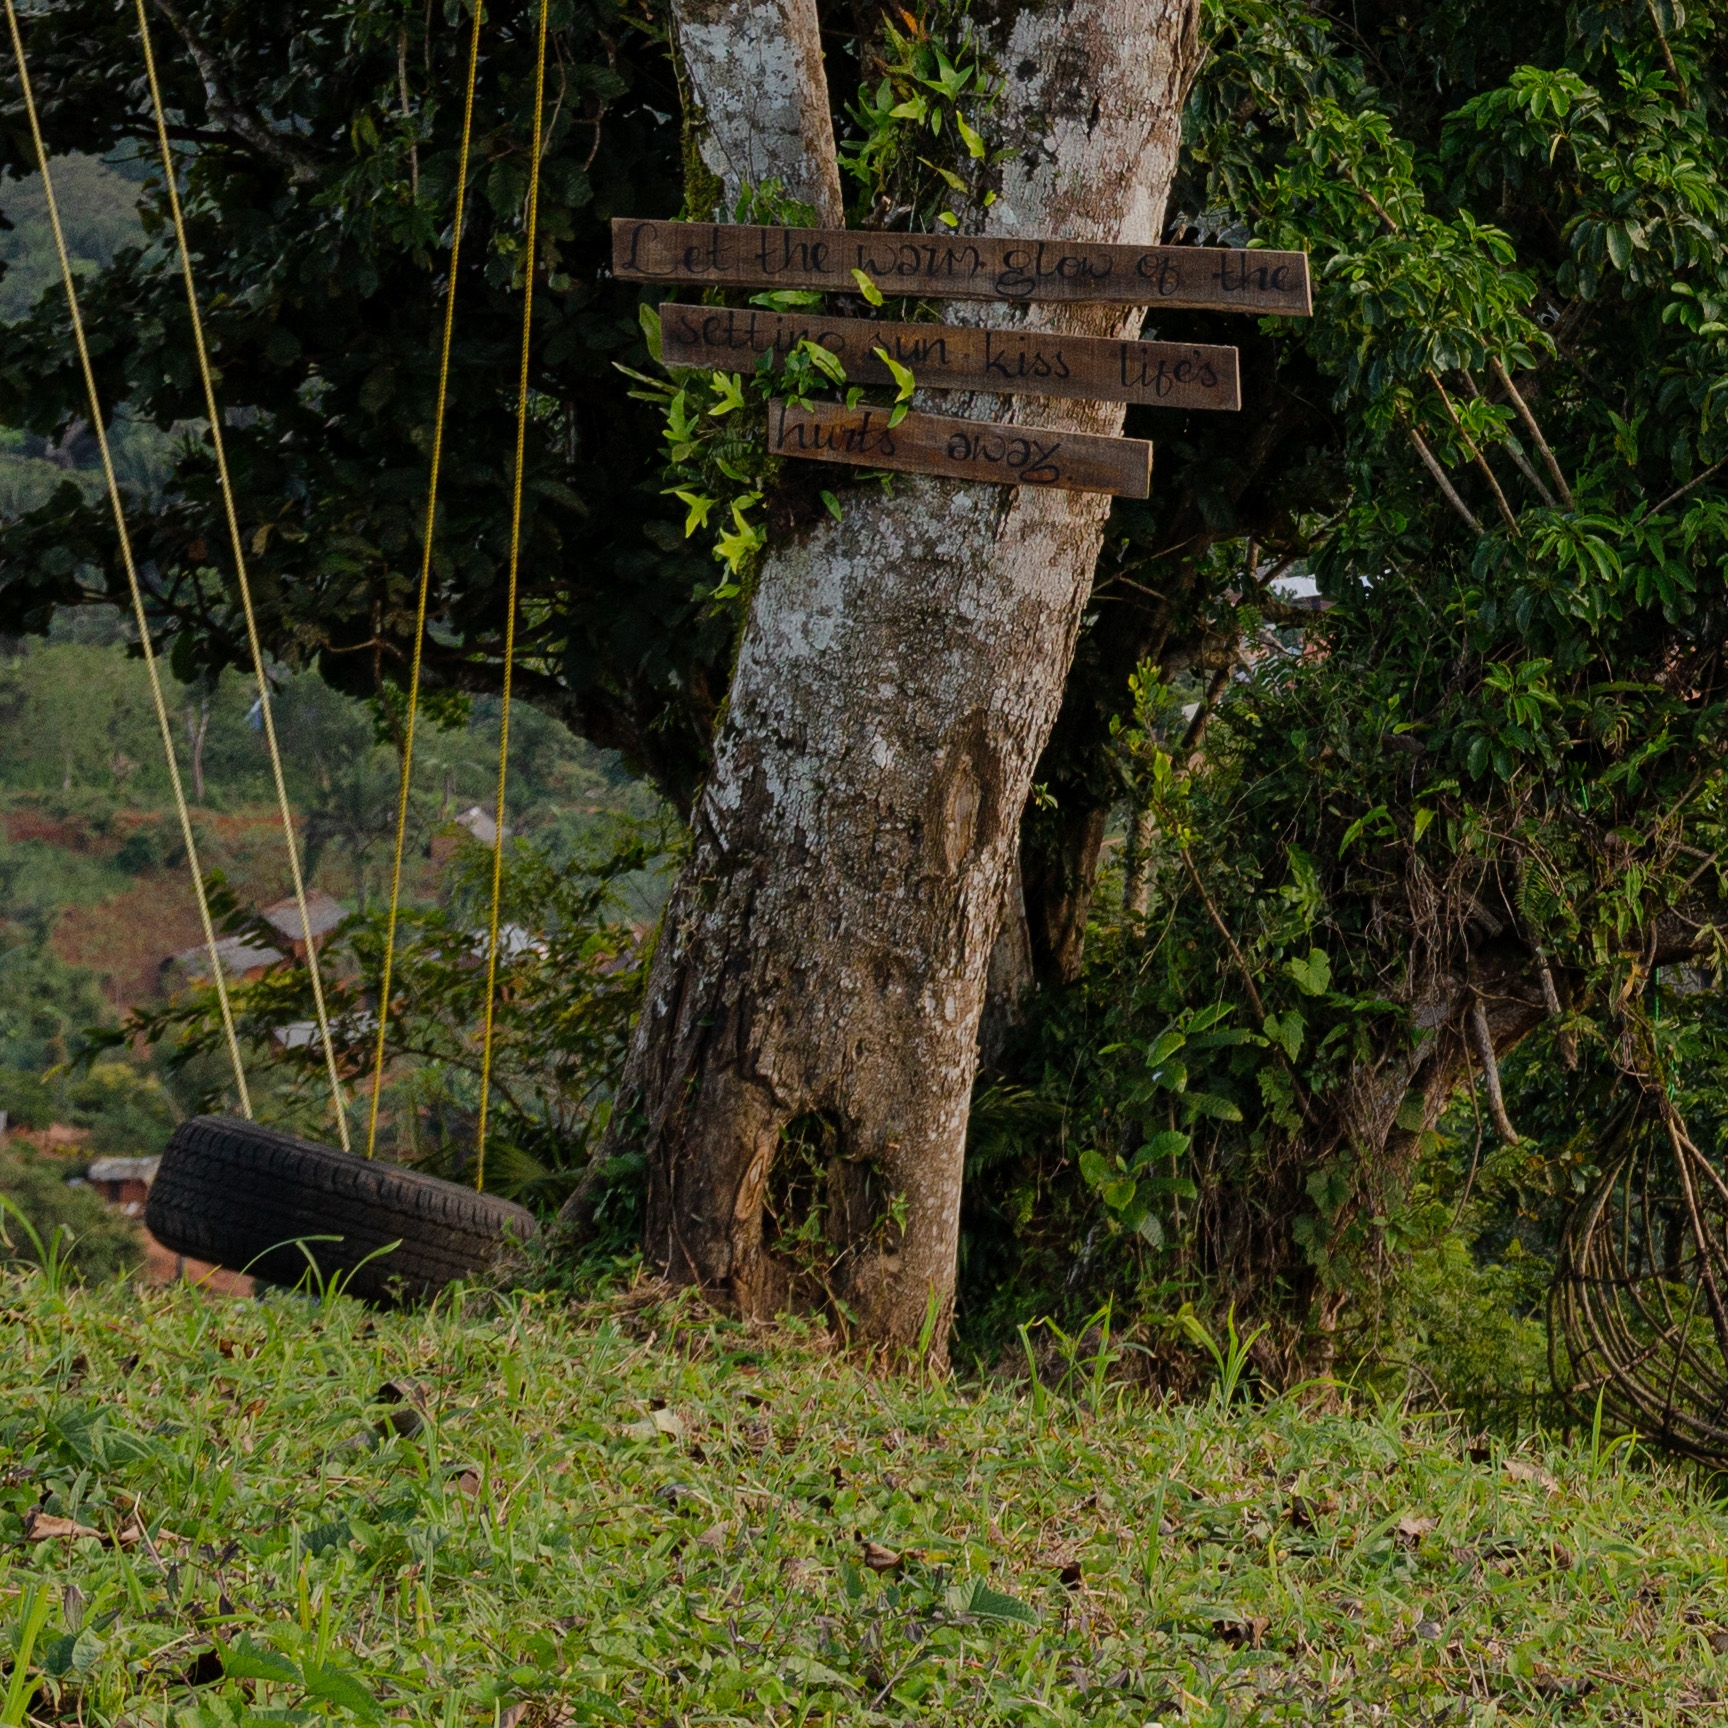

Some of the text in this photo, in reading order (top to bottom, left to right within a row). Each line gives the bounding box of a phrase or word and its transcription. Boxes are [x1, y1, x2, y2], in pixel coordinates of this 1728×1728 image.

[621, 223, 1303, 297] Let the warm glow of the
[866, 332, 950, 365] sun
[985, 331, 1071, 380] kiss
[1120, 343, 1220, 399] life's
[776, 404, 1073, 483] hurts away.
